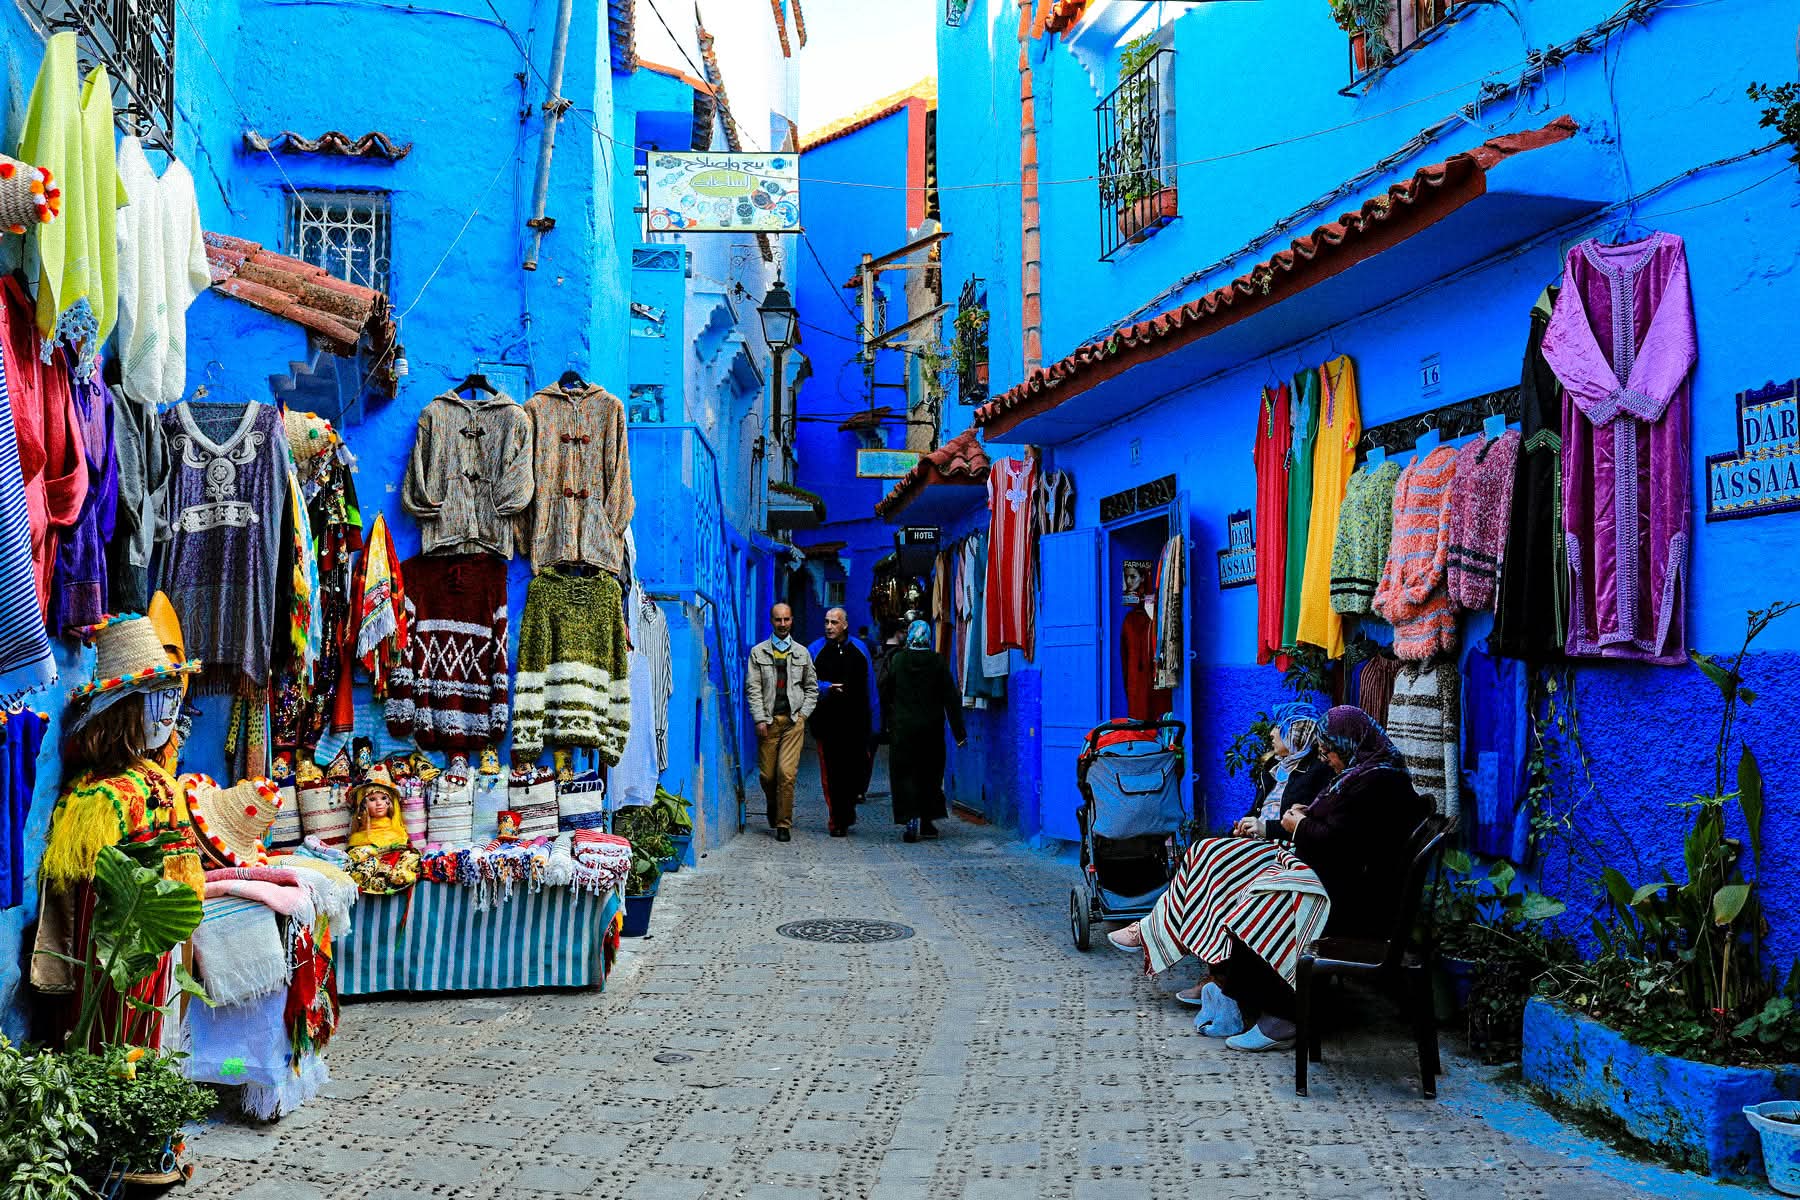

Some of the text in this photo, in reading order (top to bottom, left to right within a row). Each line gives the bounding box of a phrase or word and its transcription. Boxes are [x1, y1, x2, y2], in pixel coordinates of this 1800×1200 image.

[1423, 366, 1439, 386] 16
[1744, 409, 1798, 446] DAR
[914, 532, 935, 540] HOTEL
[1232, 527, 1250, 546] DAR
[1124, 560, 1152, 568] FARMASI
